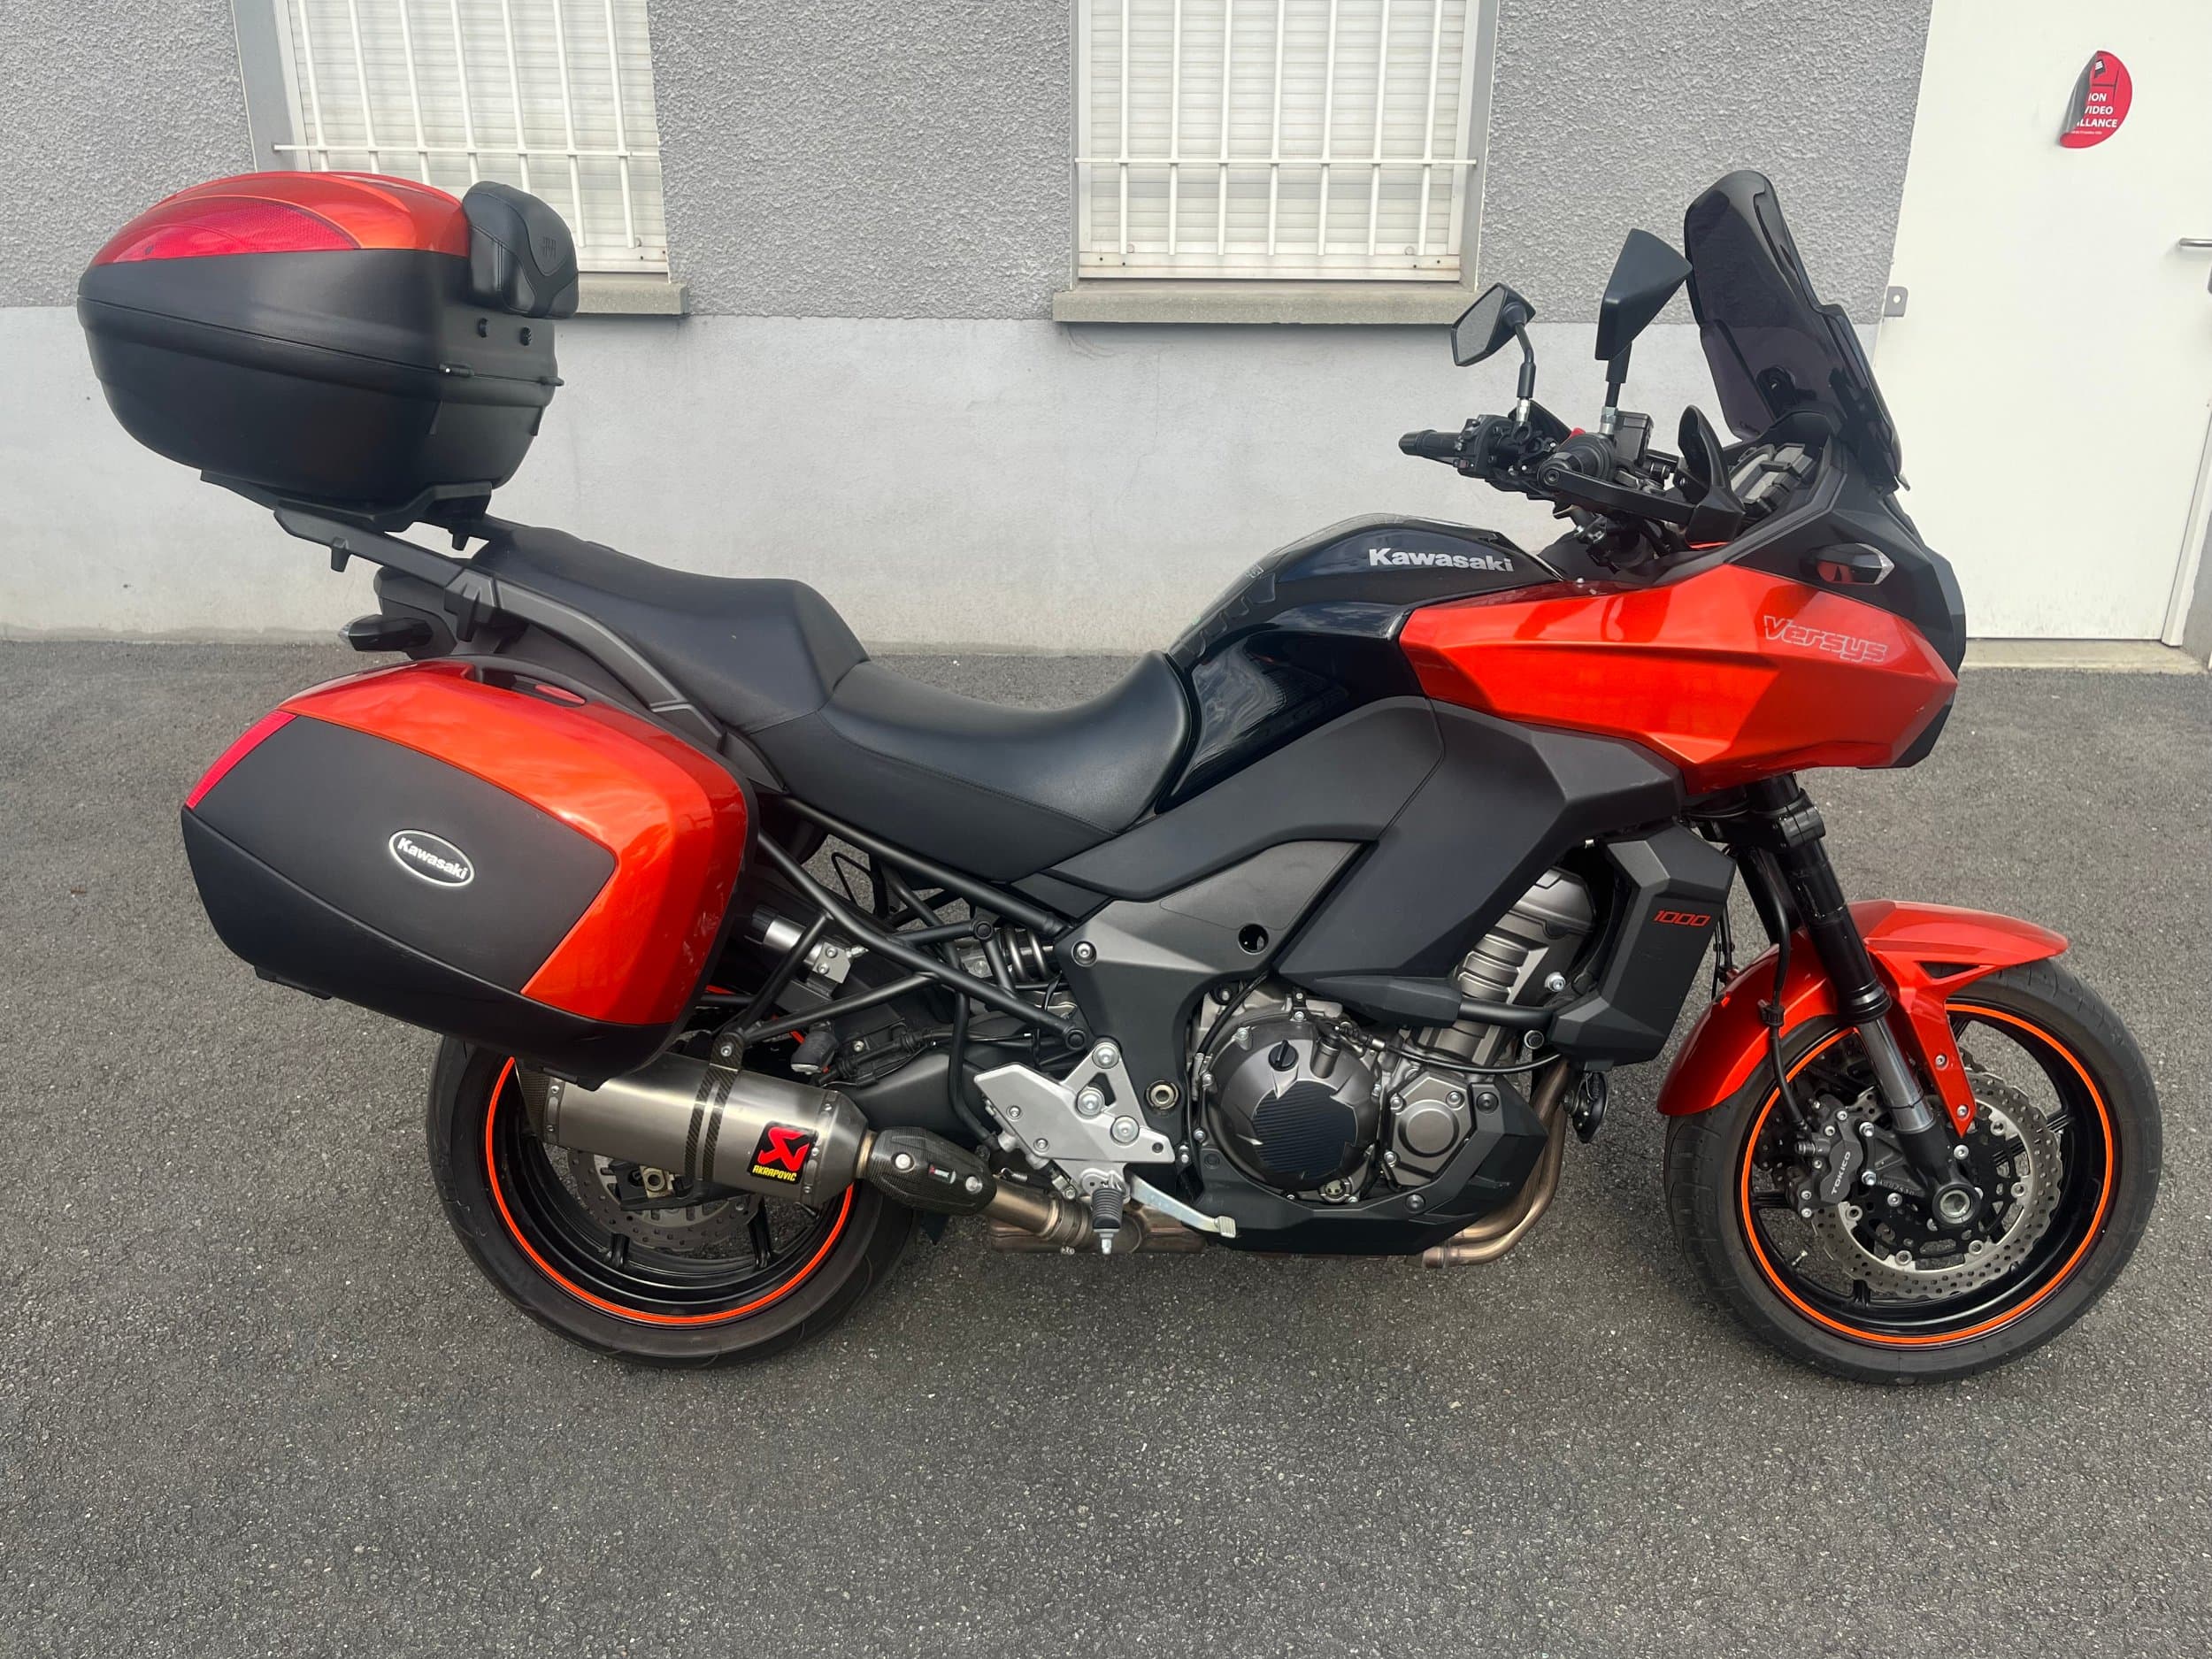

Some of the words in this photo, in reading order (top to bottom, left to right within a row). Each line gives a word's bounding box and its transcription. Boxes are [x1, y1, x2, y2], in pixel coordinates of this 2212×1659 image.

[1369, 548, 1514, 572] Kawasaki
[1763, 615, 1888, 663] Versys
[397, 837, 468, 879] Kawasaki
[1654, 910, 1711, 927] 1000
[1832, 1151, 1851, 1195] TOKICO
